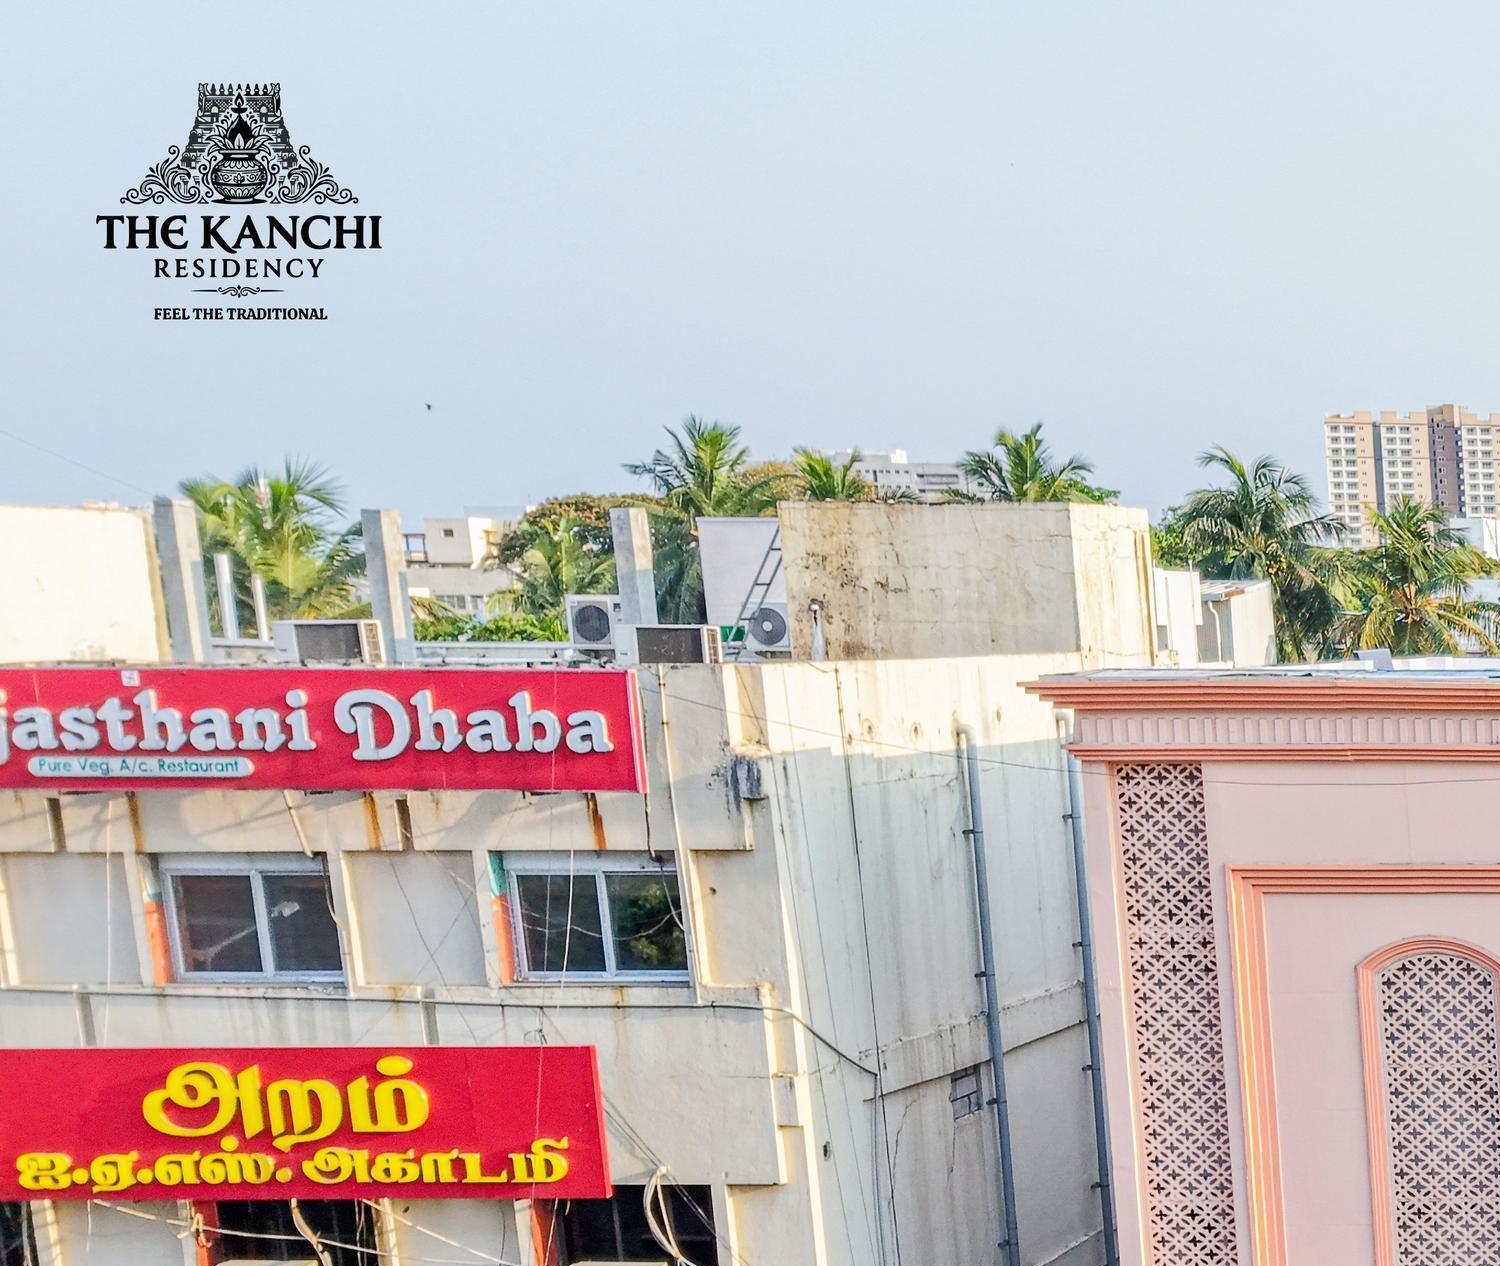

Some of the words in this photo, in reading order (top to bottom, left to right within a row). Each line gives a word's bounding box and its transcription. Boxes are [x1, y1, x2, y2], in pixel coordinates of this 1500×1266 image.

[334, 688, 613, 762] Dhaba
[38, 758, 72, 773] Pure
[78, 758, 114, 776] Veg.
[158, 758, 240, 774] Restaurant
[142, 1056, 430, 1150] அறம்
[302, 1136, 570, 1184] அகாடமி
